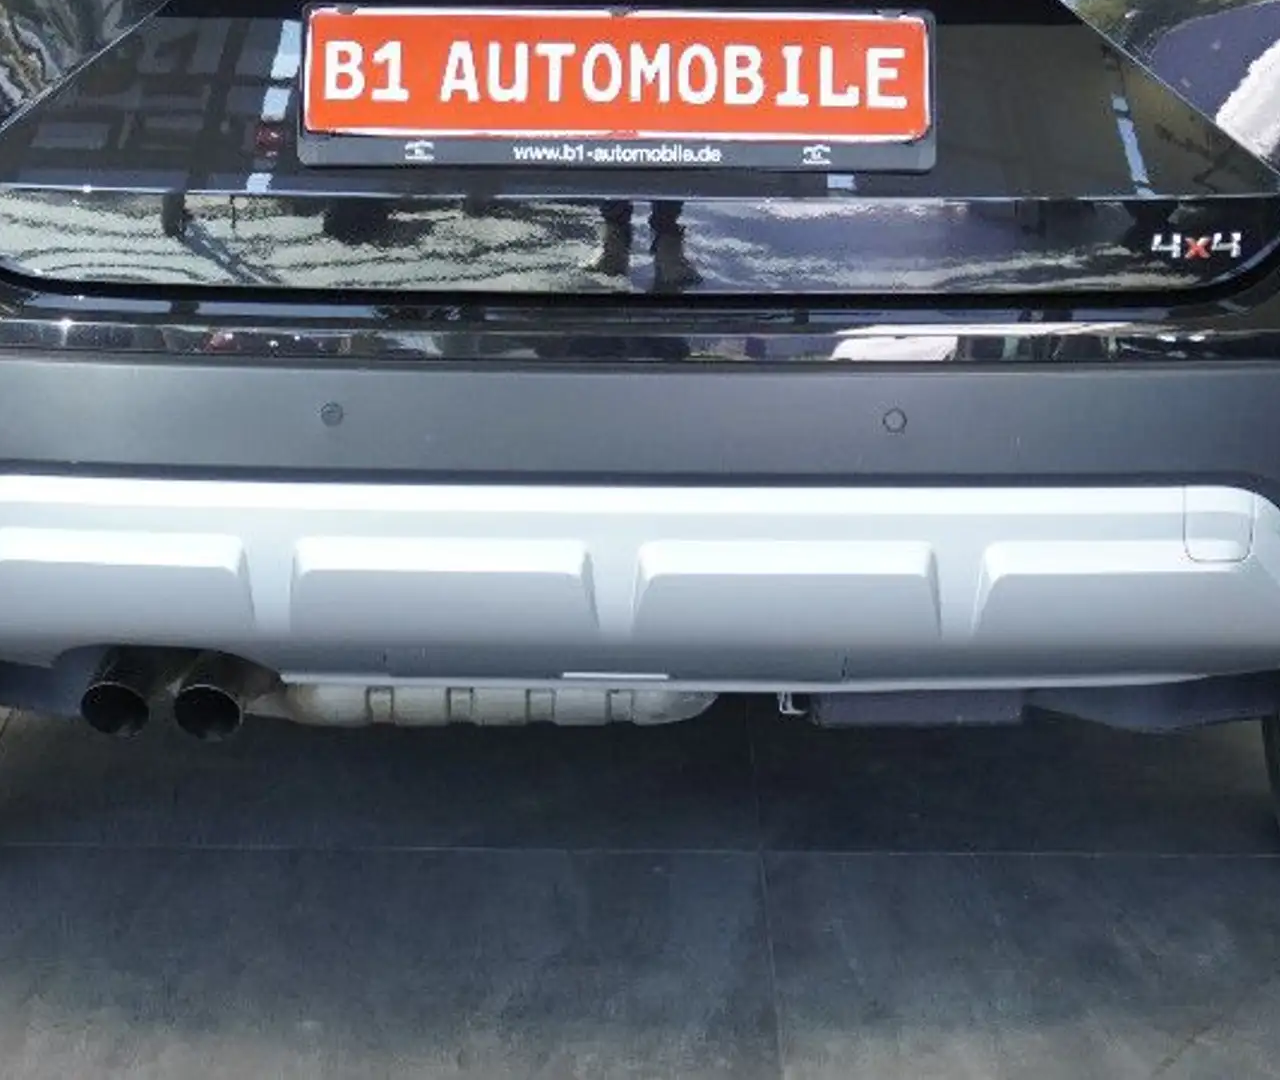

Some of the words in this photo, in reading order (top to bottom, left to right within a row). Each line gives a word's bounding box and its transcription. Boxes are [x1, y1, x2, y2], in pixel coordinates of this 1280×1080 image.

[323, 40, 410, 103] B1
[439, 40, 909, 110] AUTOMOBILE
[512, 143, 723, 164] www.b1-automobile.de
[1150, 232, 1242, 259] 4x4
